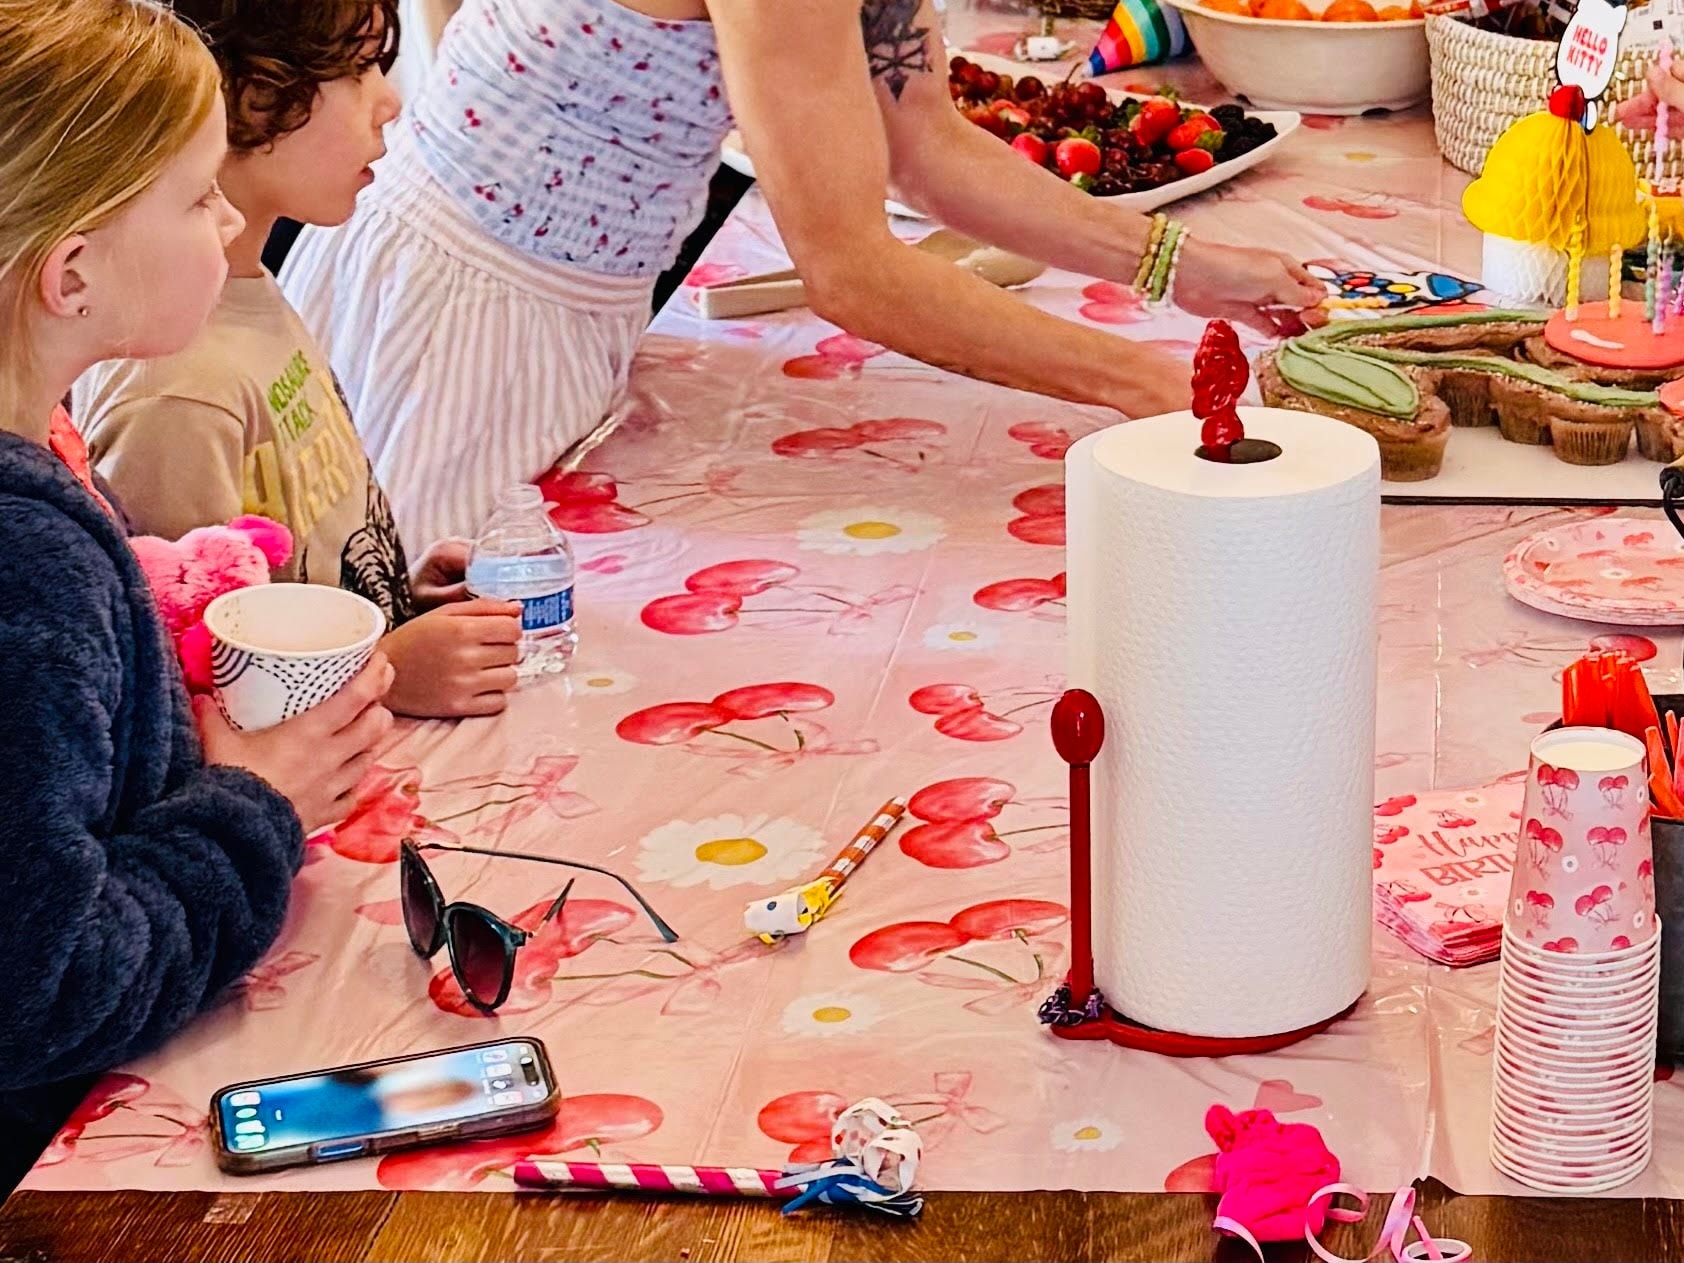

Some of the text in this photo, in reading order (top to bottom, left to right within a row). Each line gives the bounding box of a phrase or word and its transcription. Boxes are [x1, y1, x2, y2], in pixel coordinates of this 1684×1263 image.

[1573, 24, 1608, 55] HELLO
[1566, 45, 1603, 77] KITTY
[1417, 831, 1518, 858] Happ
[1420, 853, 1515, 886] BIRT
